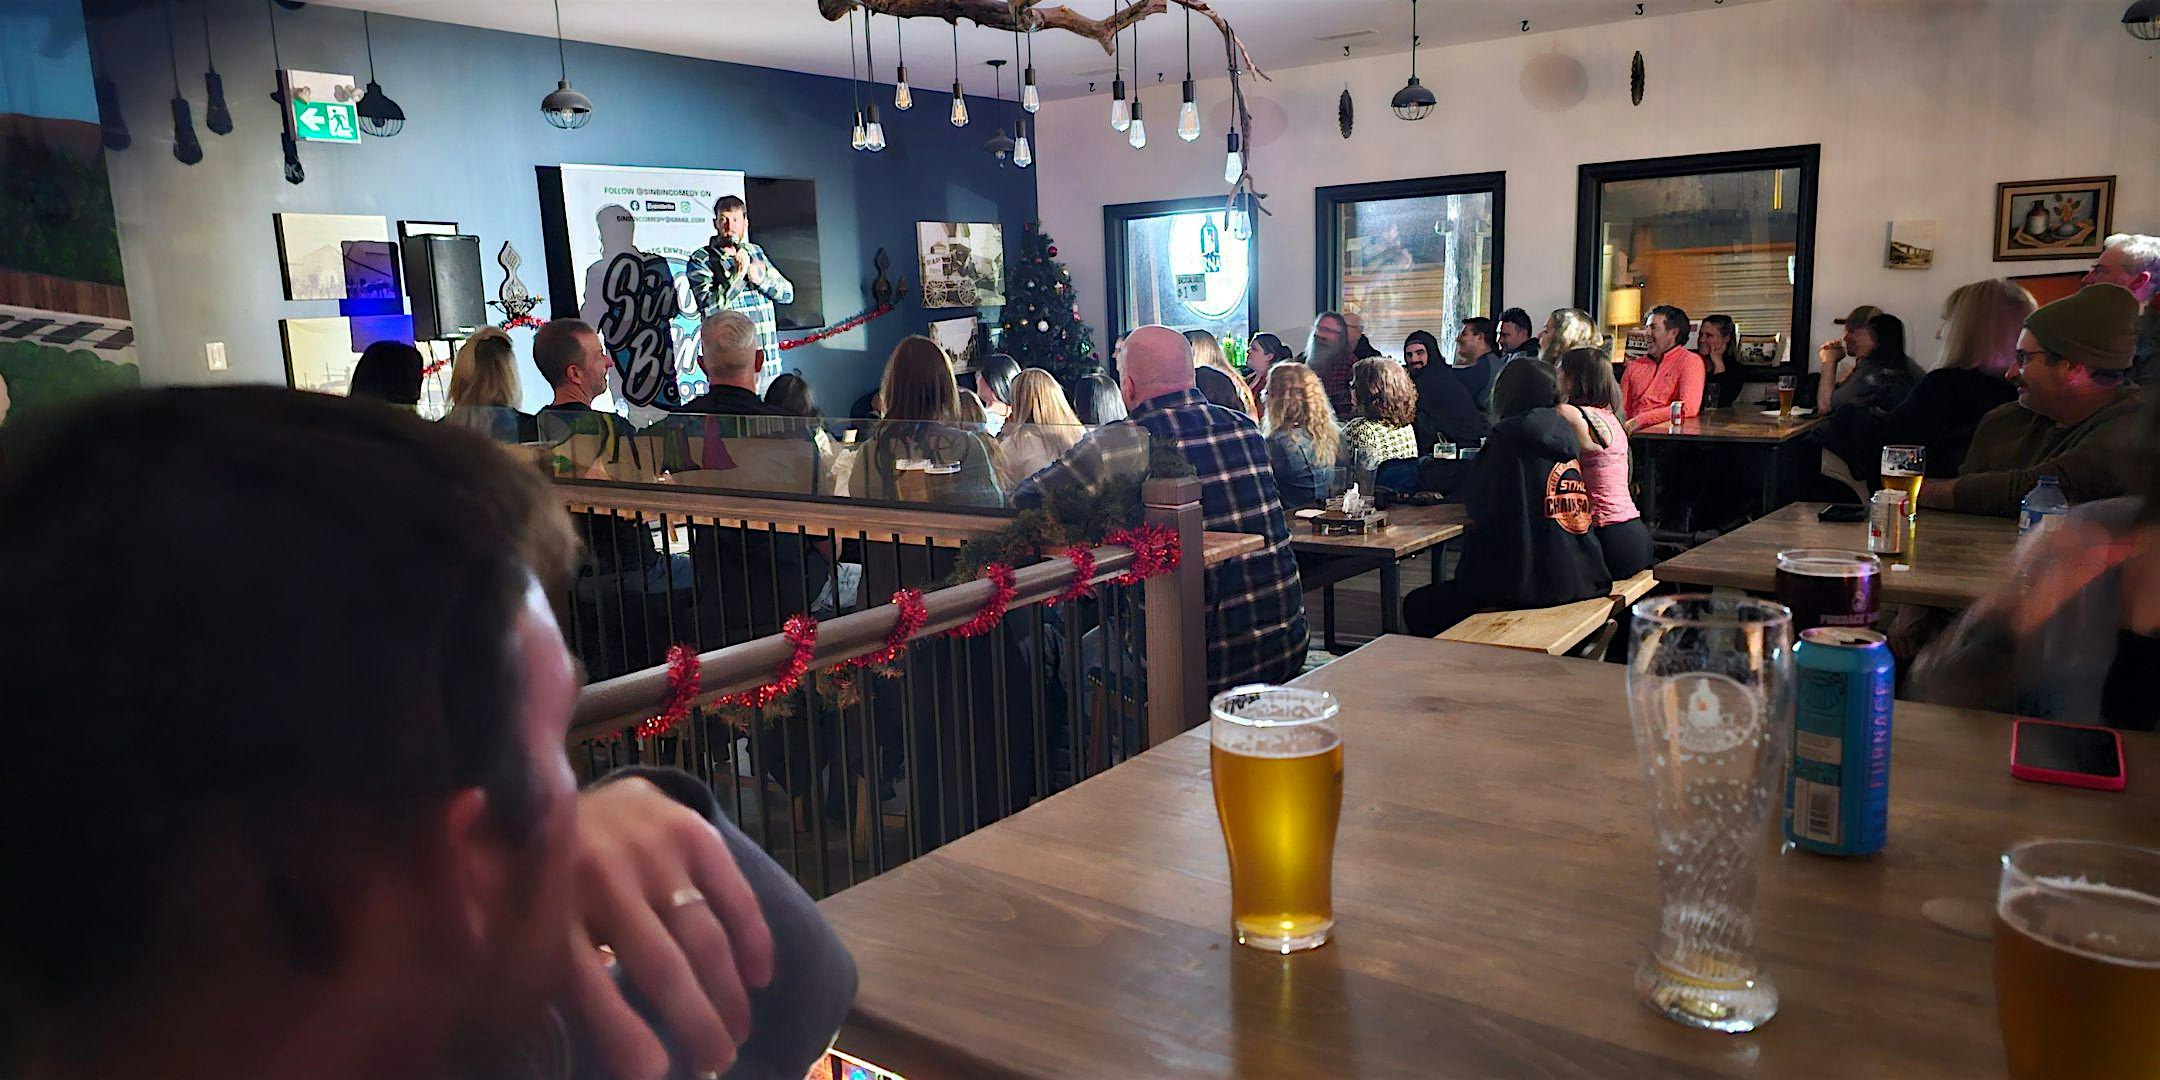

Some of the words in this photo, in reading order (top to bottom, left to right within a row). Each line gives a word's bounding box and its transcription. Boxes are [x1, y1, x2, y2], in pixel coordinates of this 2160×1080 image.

[604, 187, 634, 195] FOLLOW
[600, 254, 700, 347] Sin
[1560, 480, 1587, 492] STIHL
[1870, 680, 1889, 789] FURNACE
